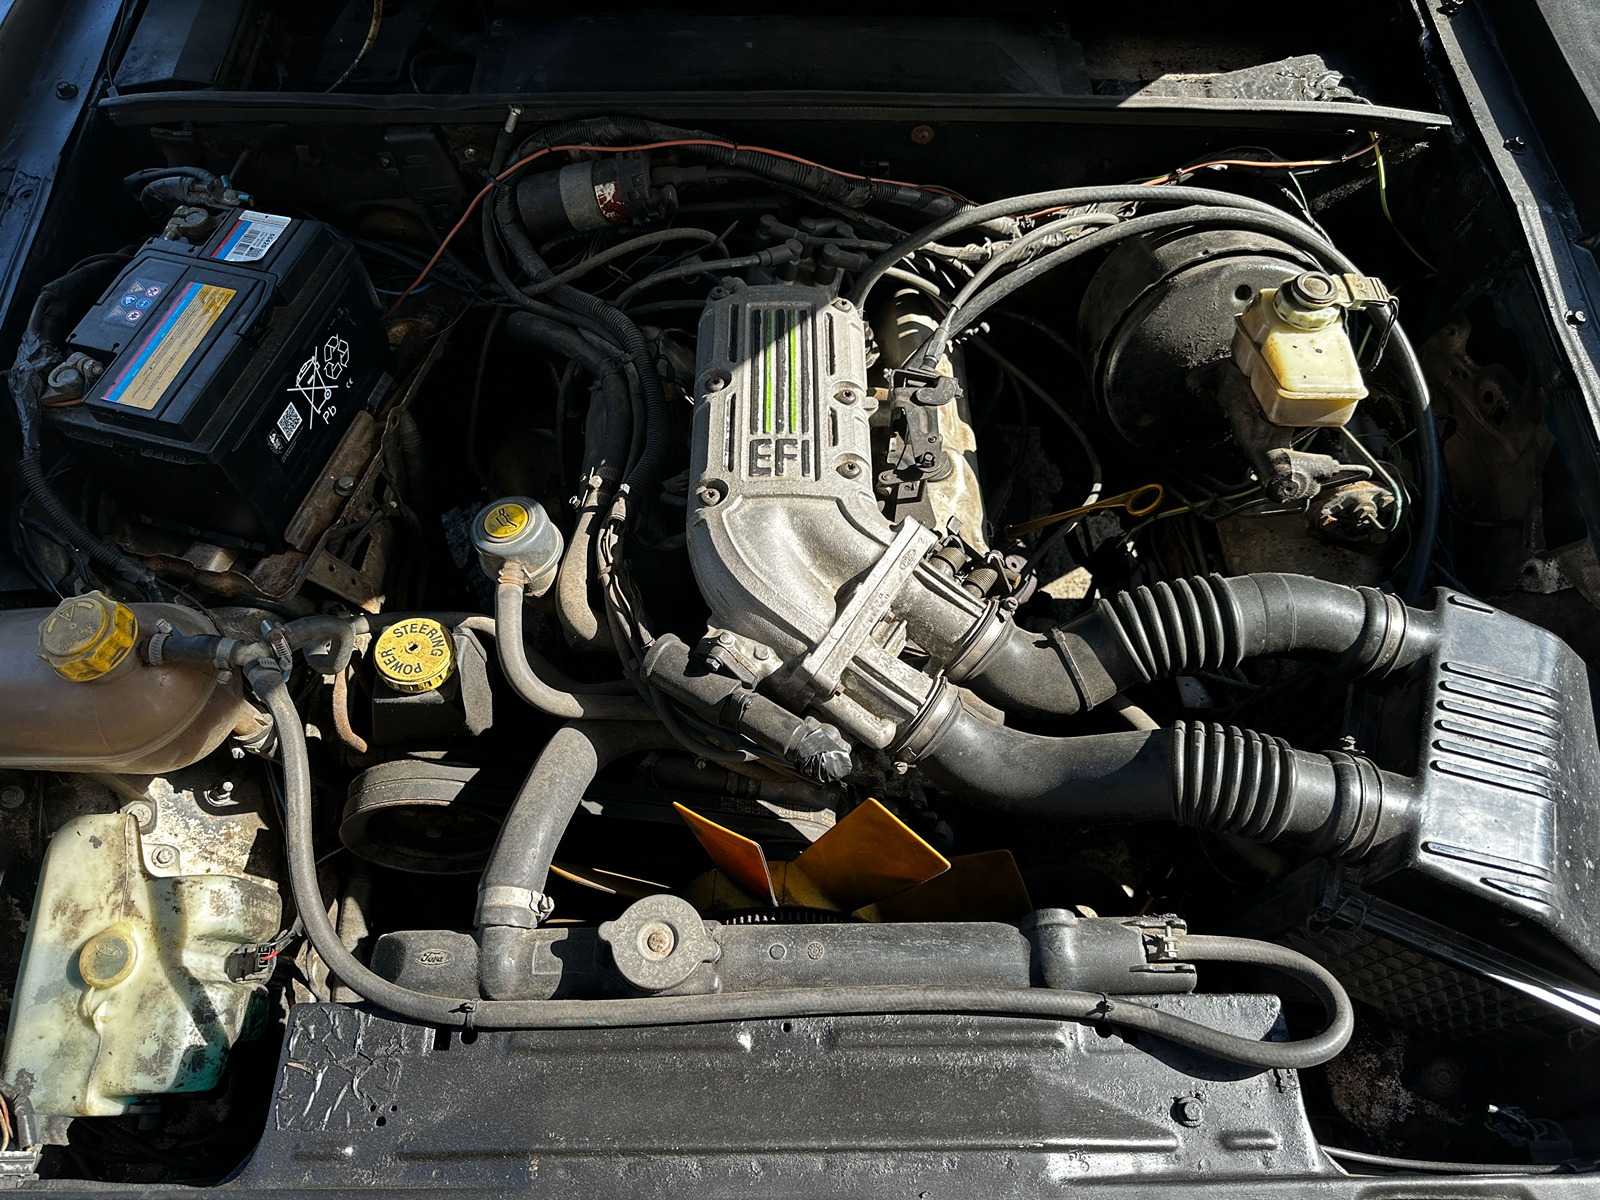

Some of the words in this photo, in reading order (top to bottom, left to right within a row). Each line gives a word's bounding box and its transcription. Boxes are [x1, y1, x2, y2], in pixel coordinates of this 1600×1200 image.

[322, 405, 337, 425] Pb
[749, 438, 811, 477] EFI
[393, 623, 445, 658] STEERING
[381, 647, 423, 675] POWER
